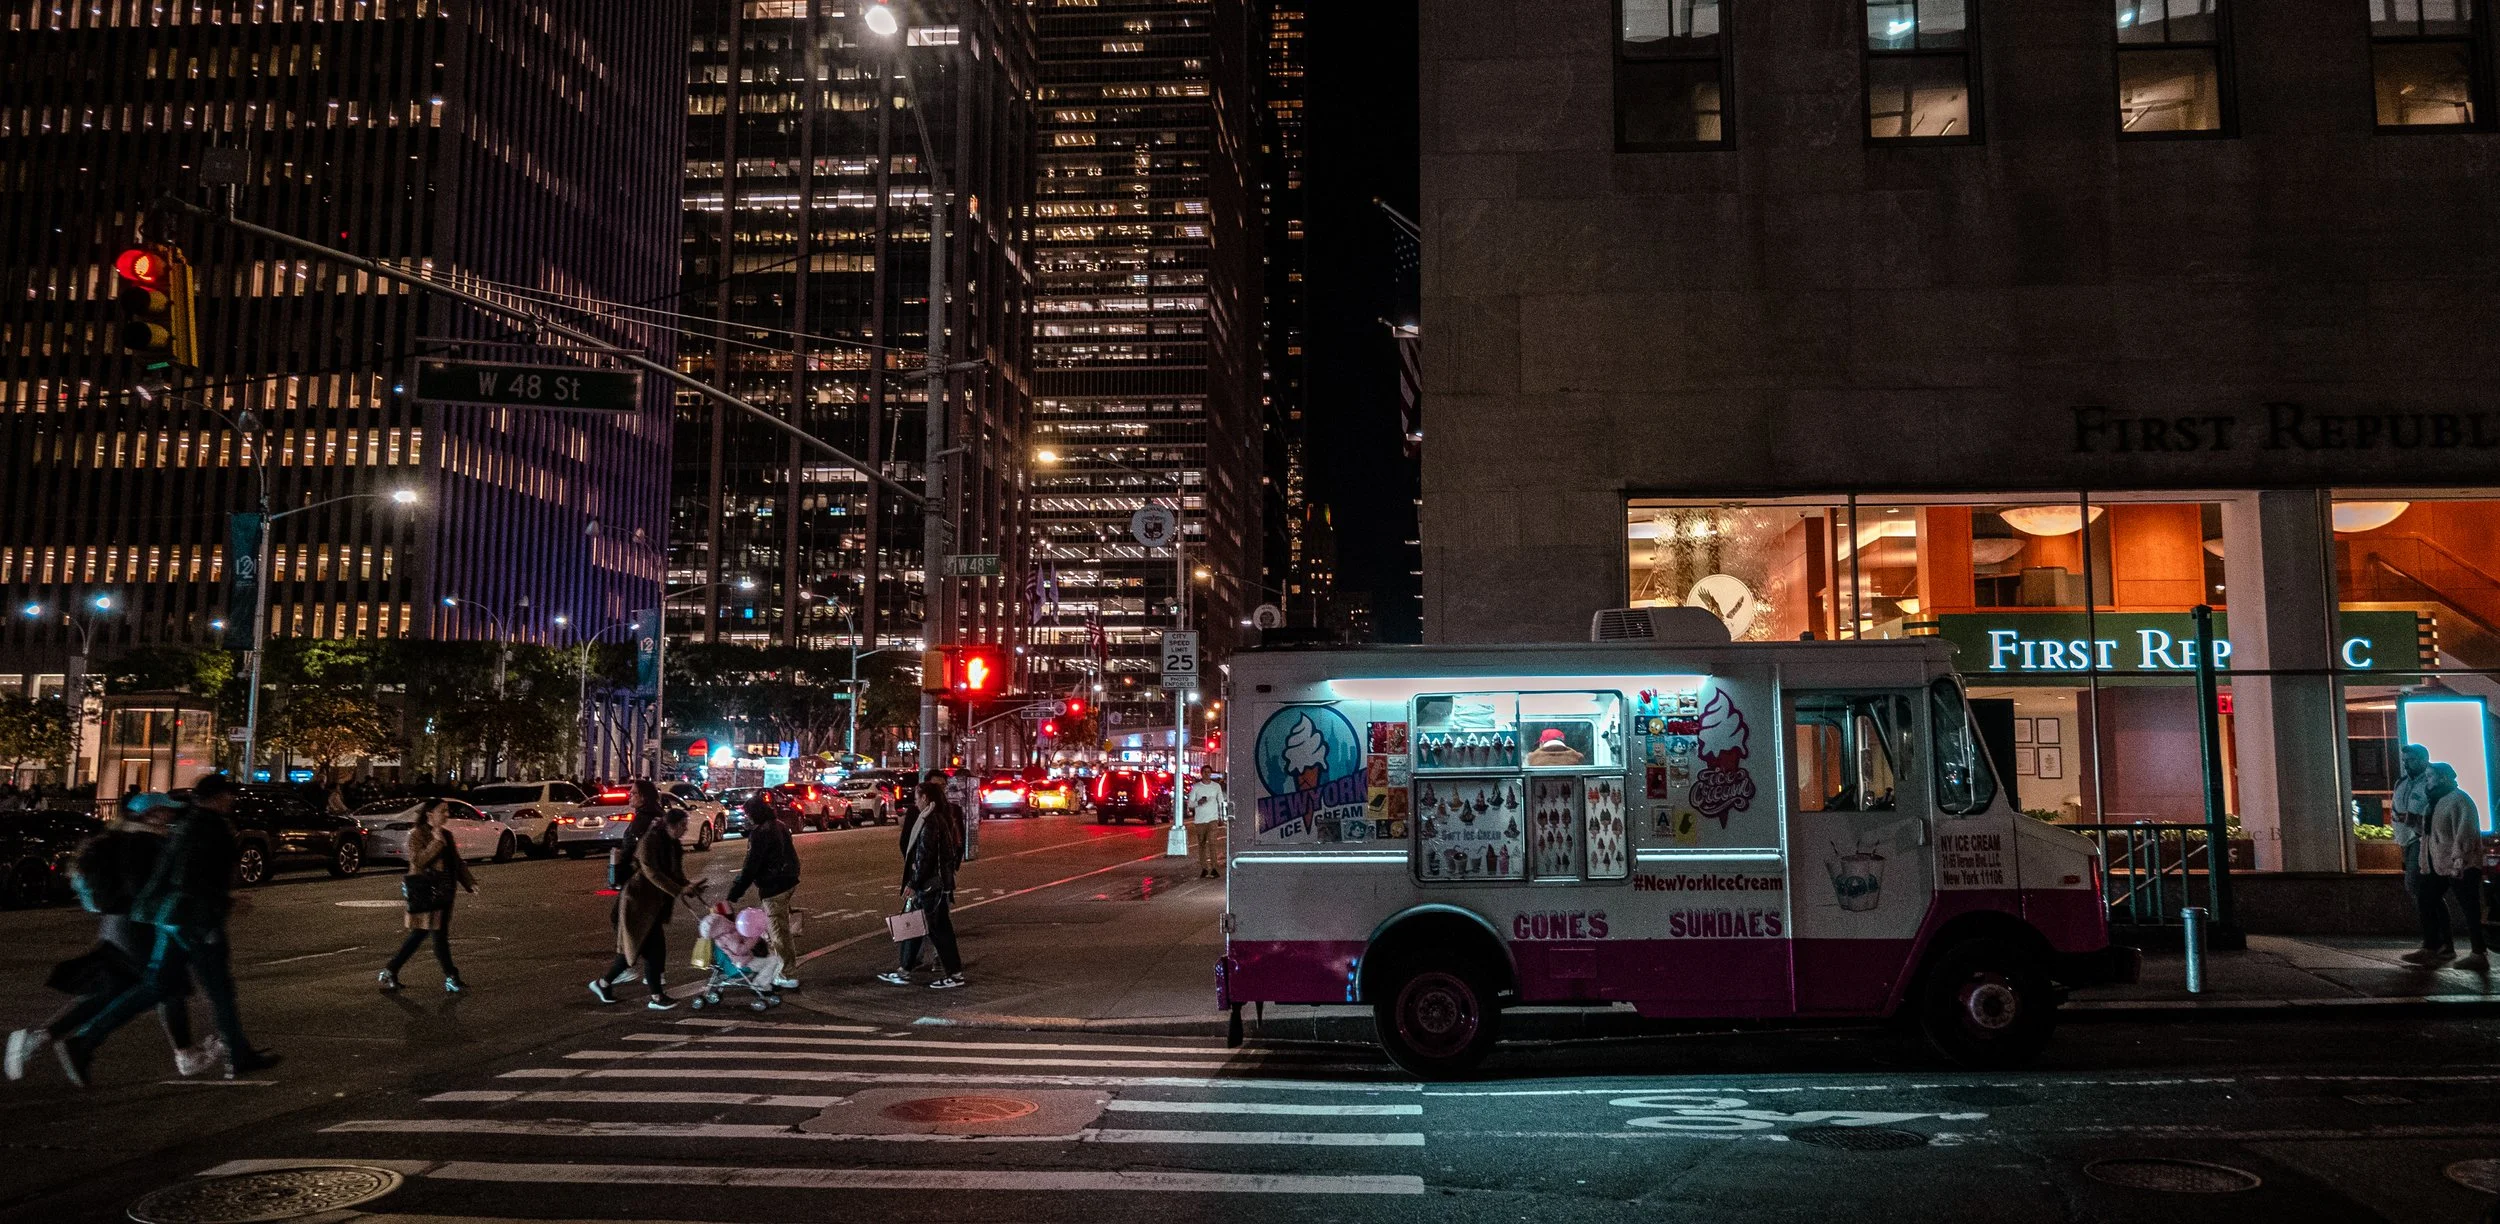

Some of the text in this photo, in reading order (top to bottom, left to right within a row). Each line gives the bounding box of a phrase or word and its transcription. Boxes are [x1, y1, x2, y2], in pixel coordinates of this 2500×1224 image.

[479, 371, 581, 401] W 48 St
[2261, 402, 2500, 451] REPUBL
[958, 557, 997, 575] W 48 ST
[1987, 629, 2117, 671] FIRST
[1167, 655, 1193, 670] 25
[1280, 805, 1364, 839] ICE CREAM
[1657, 812, 1670, 827] A
[1941, 834, 2000, 851] NY ICE CREAM
[1633, 874, 1783, 892] #NewYorkIceCream
[1943, 871, 1960, 885] New
[1960, 870, 1979, 885] York
[1512, 907, 1783, 940] CONES SUNDAES
